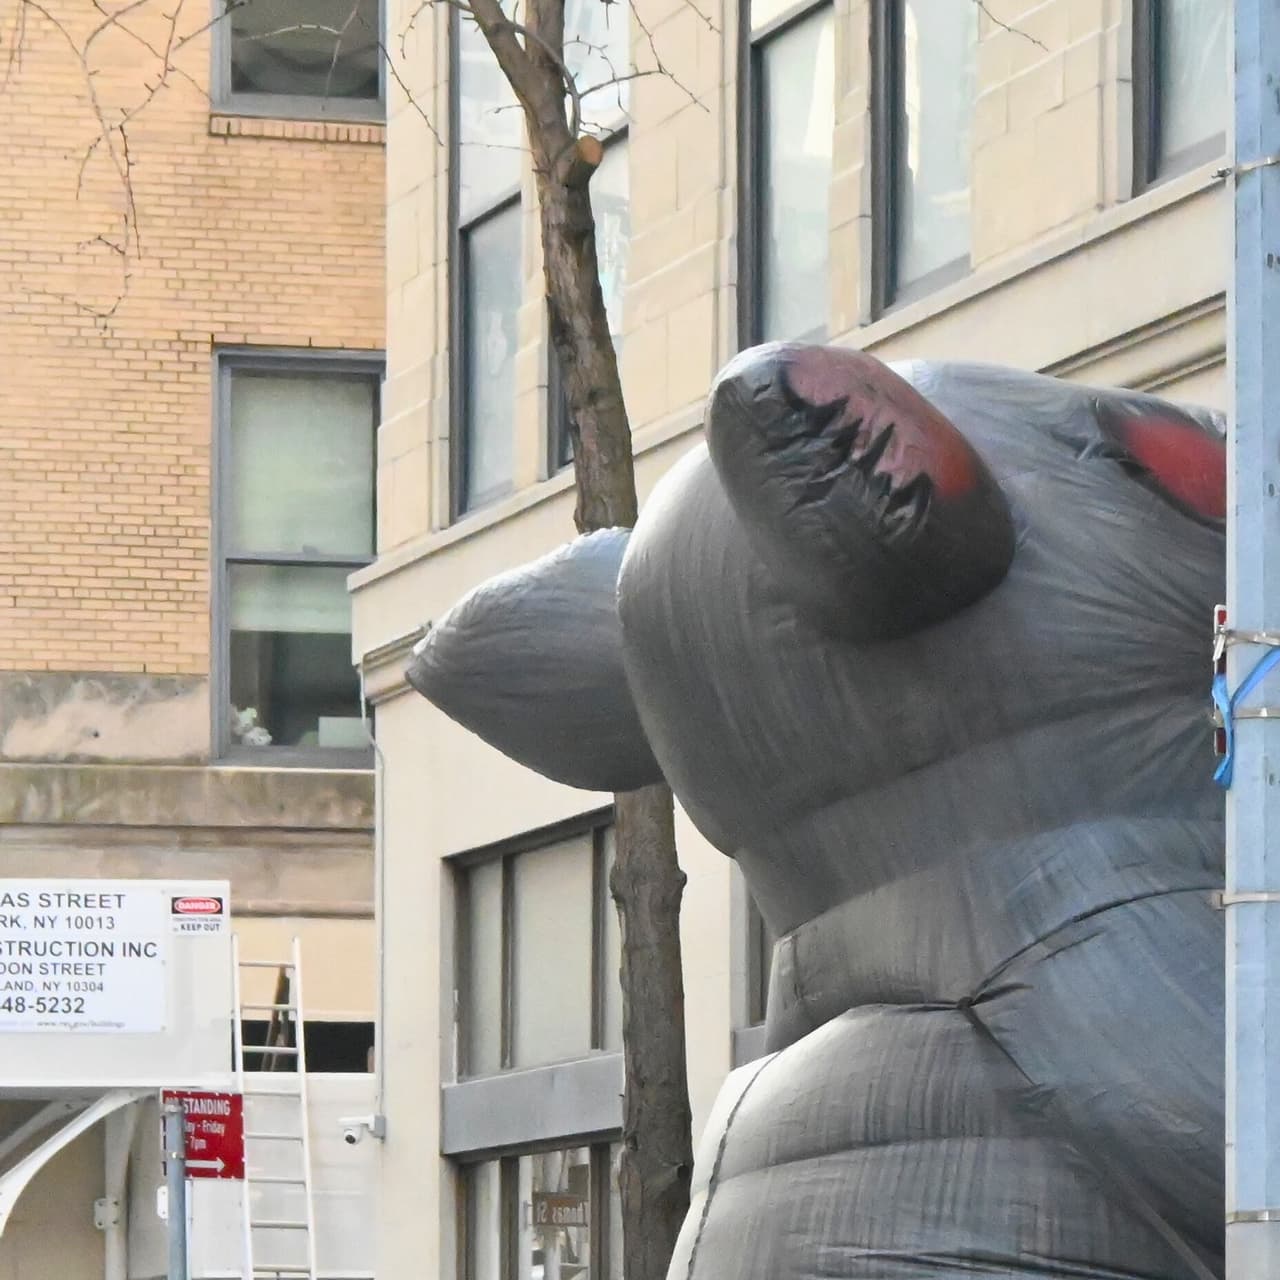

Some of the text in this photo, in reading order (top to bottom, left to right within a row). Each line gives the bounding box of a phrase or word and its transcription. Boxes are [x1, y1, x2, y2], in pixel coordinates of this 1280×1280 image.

[38, 892, 126, 909] STREET
[33, 914, 58, 929] NY
[65, 914, 115, 930] 10013
[0, 940, 157, 958] TRUCTION INC
[39, 962, 106, 976] STREET
[43, 981, 61, 991] NY
[67, 981, 104, 992] 10304
[0, 996, 85, 1013] 48-5232
[182, 1098, 231, 1116] STANDING
